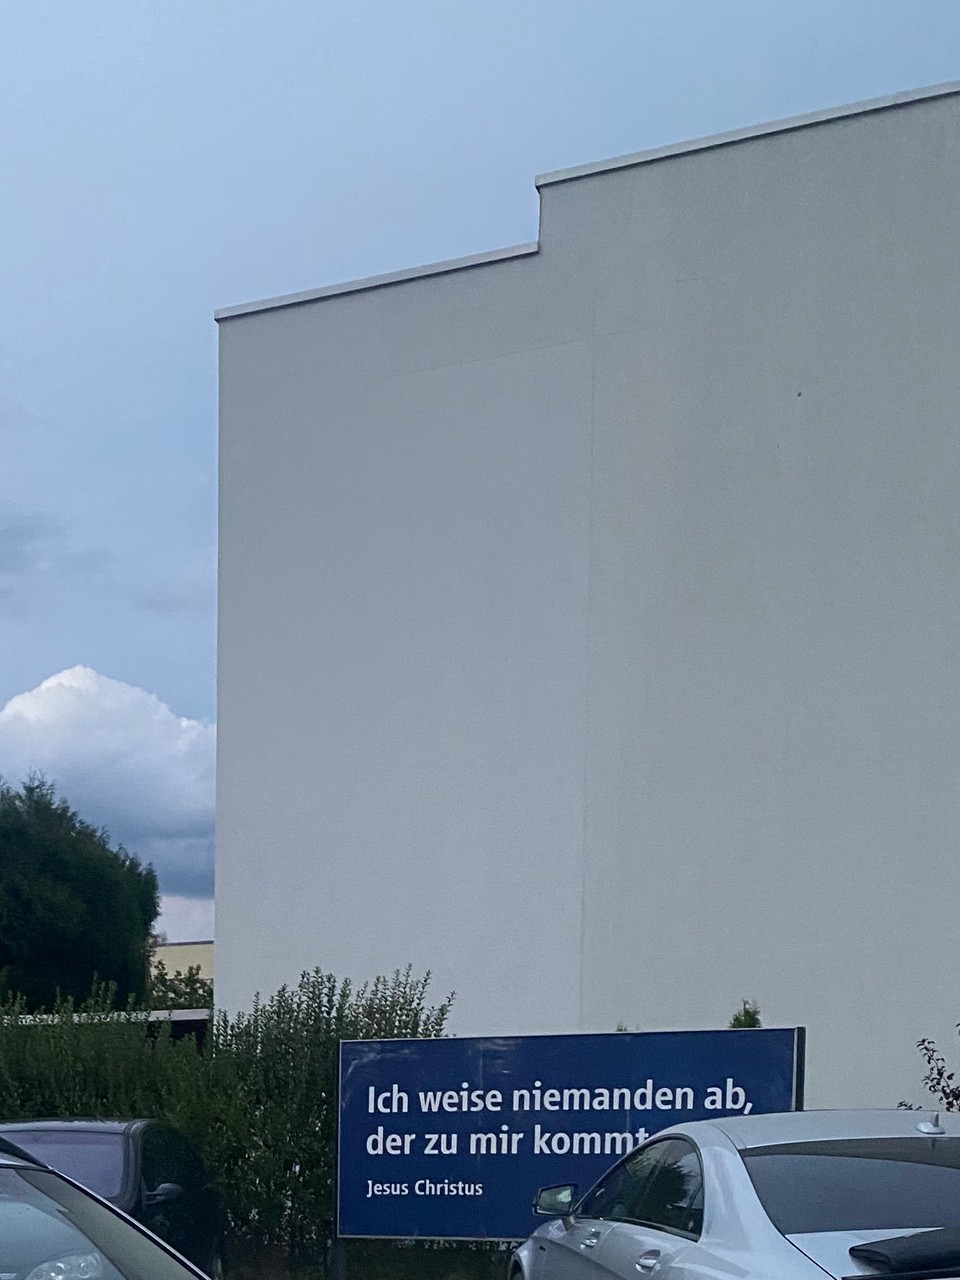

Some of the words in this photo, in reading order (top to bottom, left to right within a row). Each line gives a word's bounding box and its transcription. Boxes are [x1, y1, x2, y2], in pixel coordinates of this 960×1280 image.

[368, 1084, 408, 1113] Ich
[419, 1082, 503, 1112] weise
[513, 1079, 694, 1111] niemanden
[704, 1078, 753, 1115] ab,
[366, 1126, 415, 1155] der
[424, 1134, 458, 1155] zu
[470, 1125, 524, 1154] mir
[534, 1125, 649, 1155] kommt
[367, 1180, 409, 1198] Jesus
[415, 1179, 483, 1196] Christus
